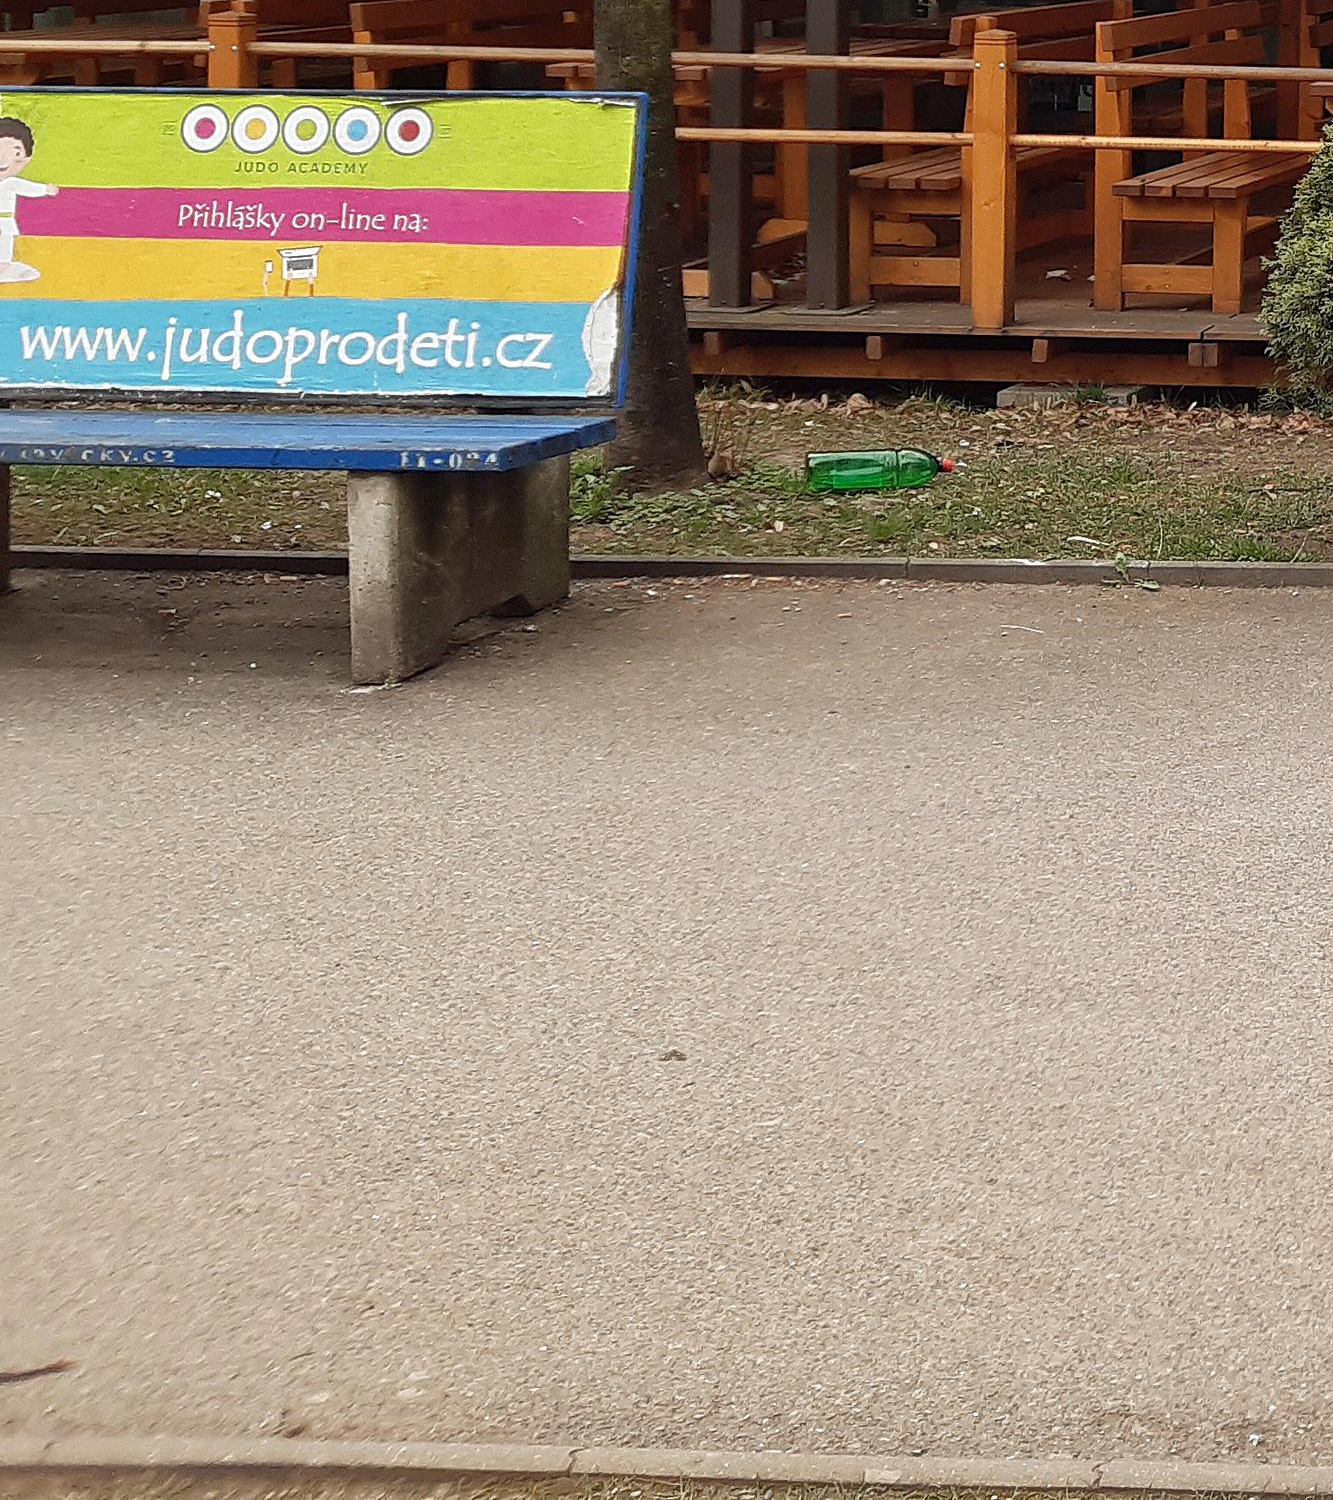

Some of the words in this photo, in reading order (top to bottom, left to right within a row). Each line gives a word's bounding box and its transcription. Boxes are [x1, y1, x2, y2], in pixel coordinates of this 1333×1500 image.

[234, 160, 279, 174] JUDO
[287, 162, 369, 175] ACADEMY
[178, 200, 285, 236] Přihlášky
[291, 203, 385, 231] on-line
[393, 211, 430, 232] na:
[20, 309, 554, 387] www.judoprodeti.cz
